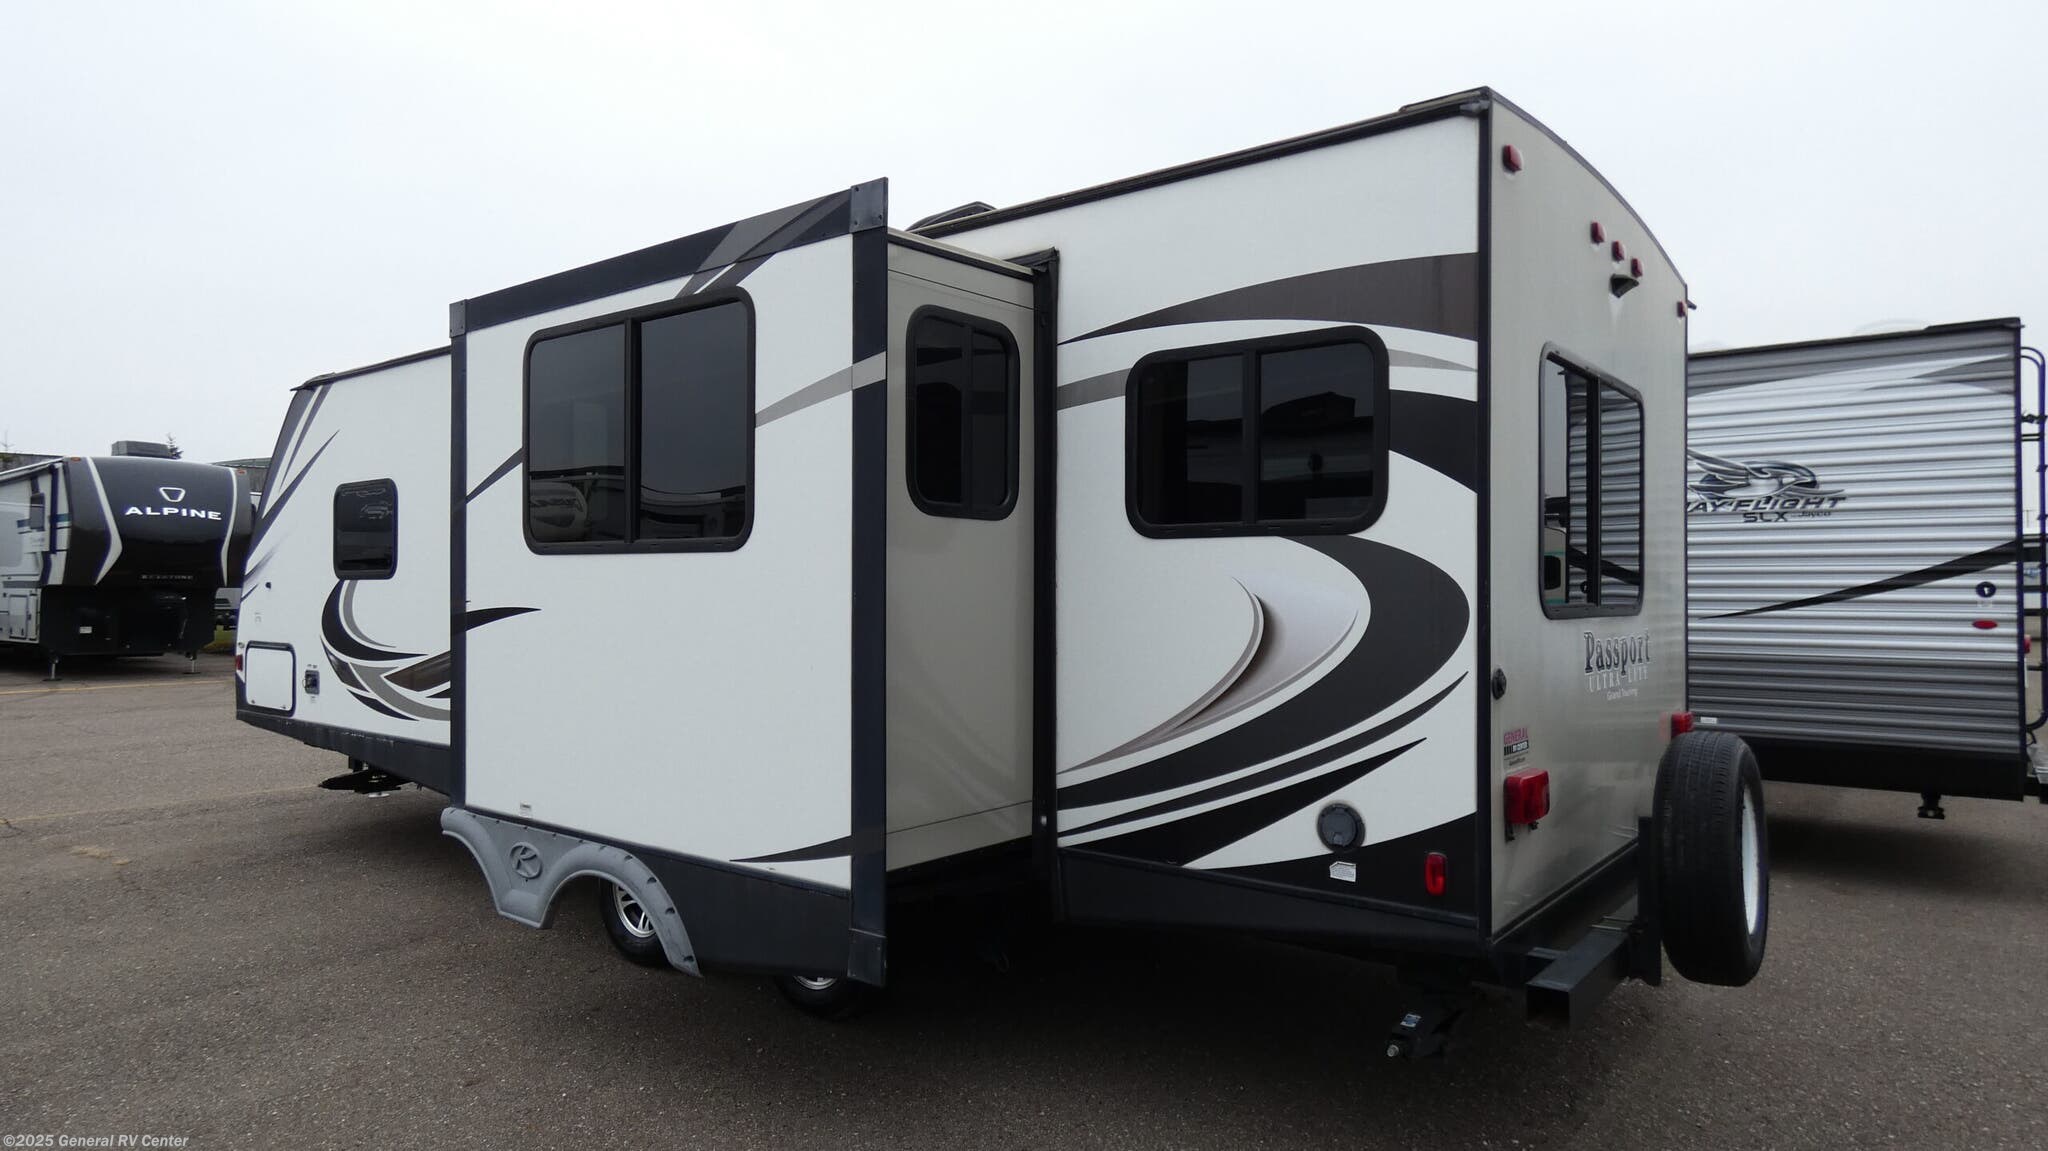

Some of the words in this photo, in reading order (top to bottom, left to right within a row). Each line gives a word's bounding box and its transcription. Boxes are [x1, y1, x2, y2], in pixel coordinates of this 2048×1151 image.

[1686, 500, 1733, 513] AY
[1732, 497, 1847, 512] FLIGHT
[125, 506, 222, 521] ALPINE
[1742, 511, 1789, 523] SLX
[1584, 629, 1650, 676] Passport
